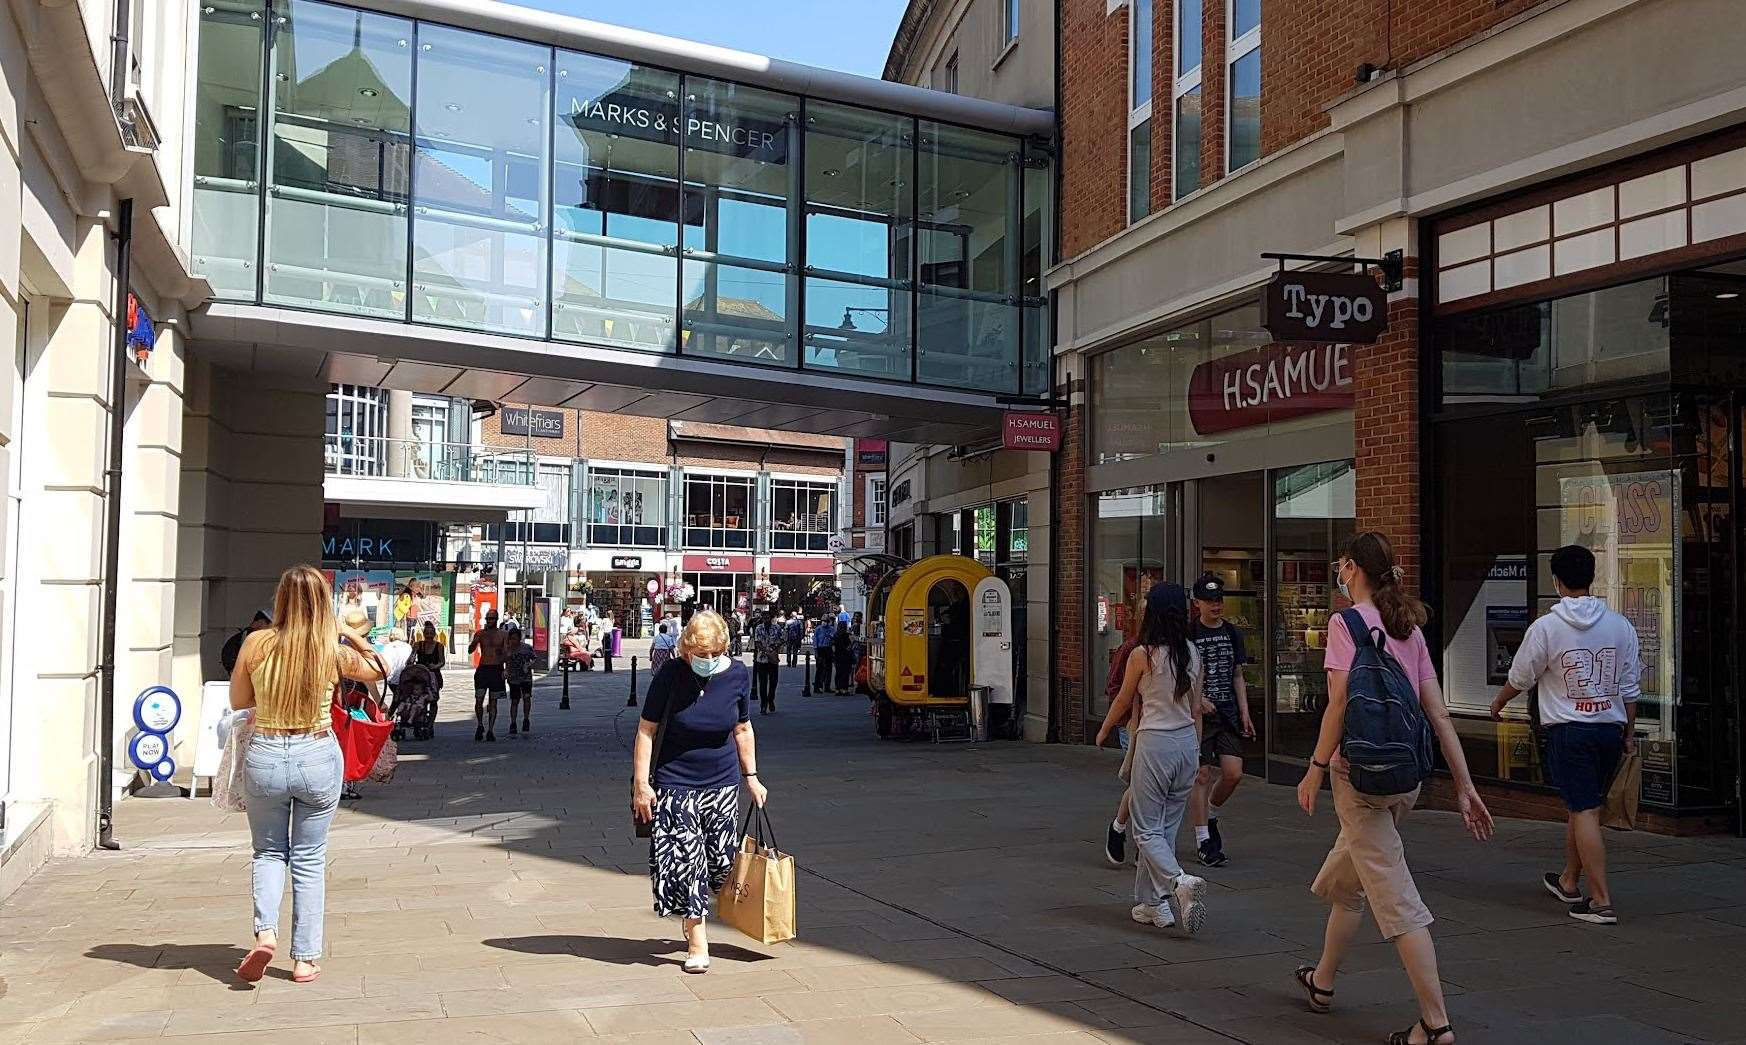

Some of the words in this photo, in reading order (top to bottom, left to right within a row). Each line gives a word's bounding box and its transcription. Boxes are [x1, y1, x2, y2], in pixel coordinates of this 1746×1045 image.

[571, 97, 650, 128] MARKS
[654, 113, 668, 131] &
[672, 117, 774, 151] SPENCER
[1283, 284, 1374, 329] Typo
[505, 411, 561, 432] Whitefriars
[1009, 419, 1055, 430] H.SAMUEL
[1014, 435, 1051, 445] JEWELLERS
[321, 537, 393, 556] MARK
[706, 557, 731, 566] COSTA
[1561, 647, 1620, 699] 21
